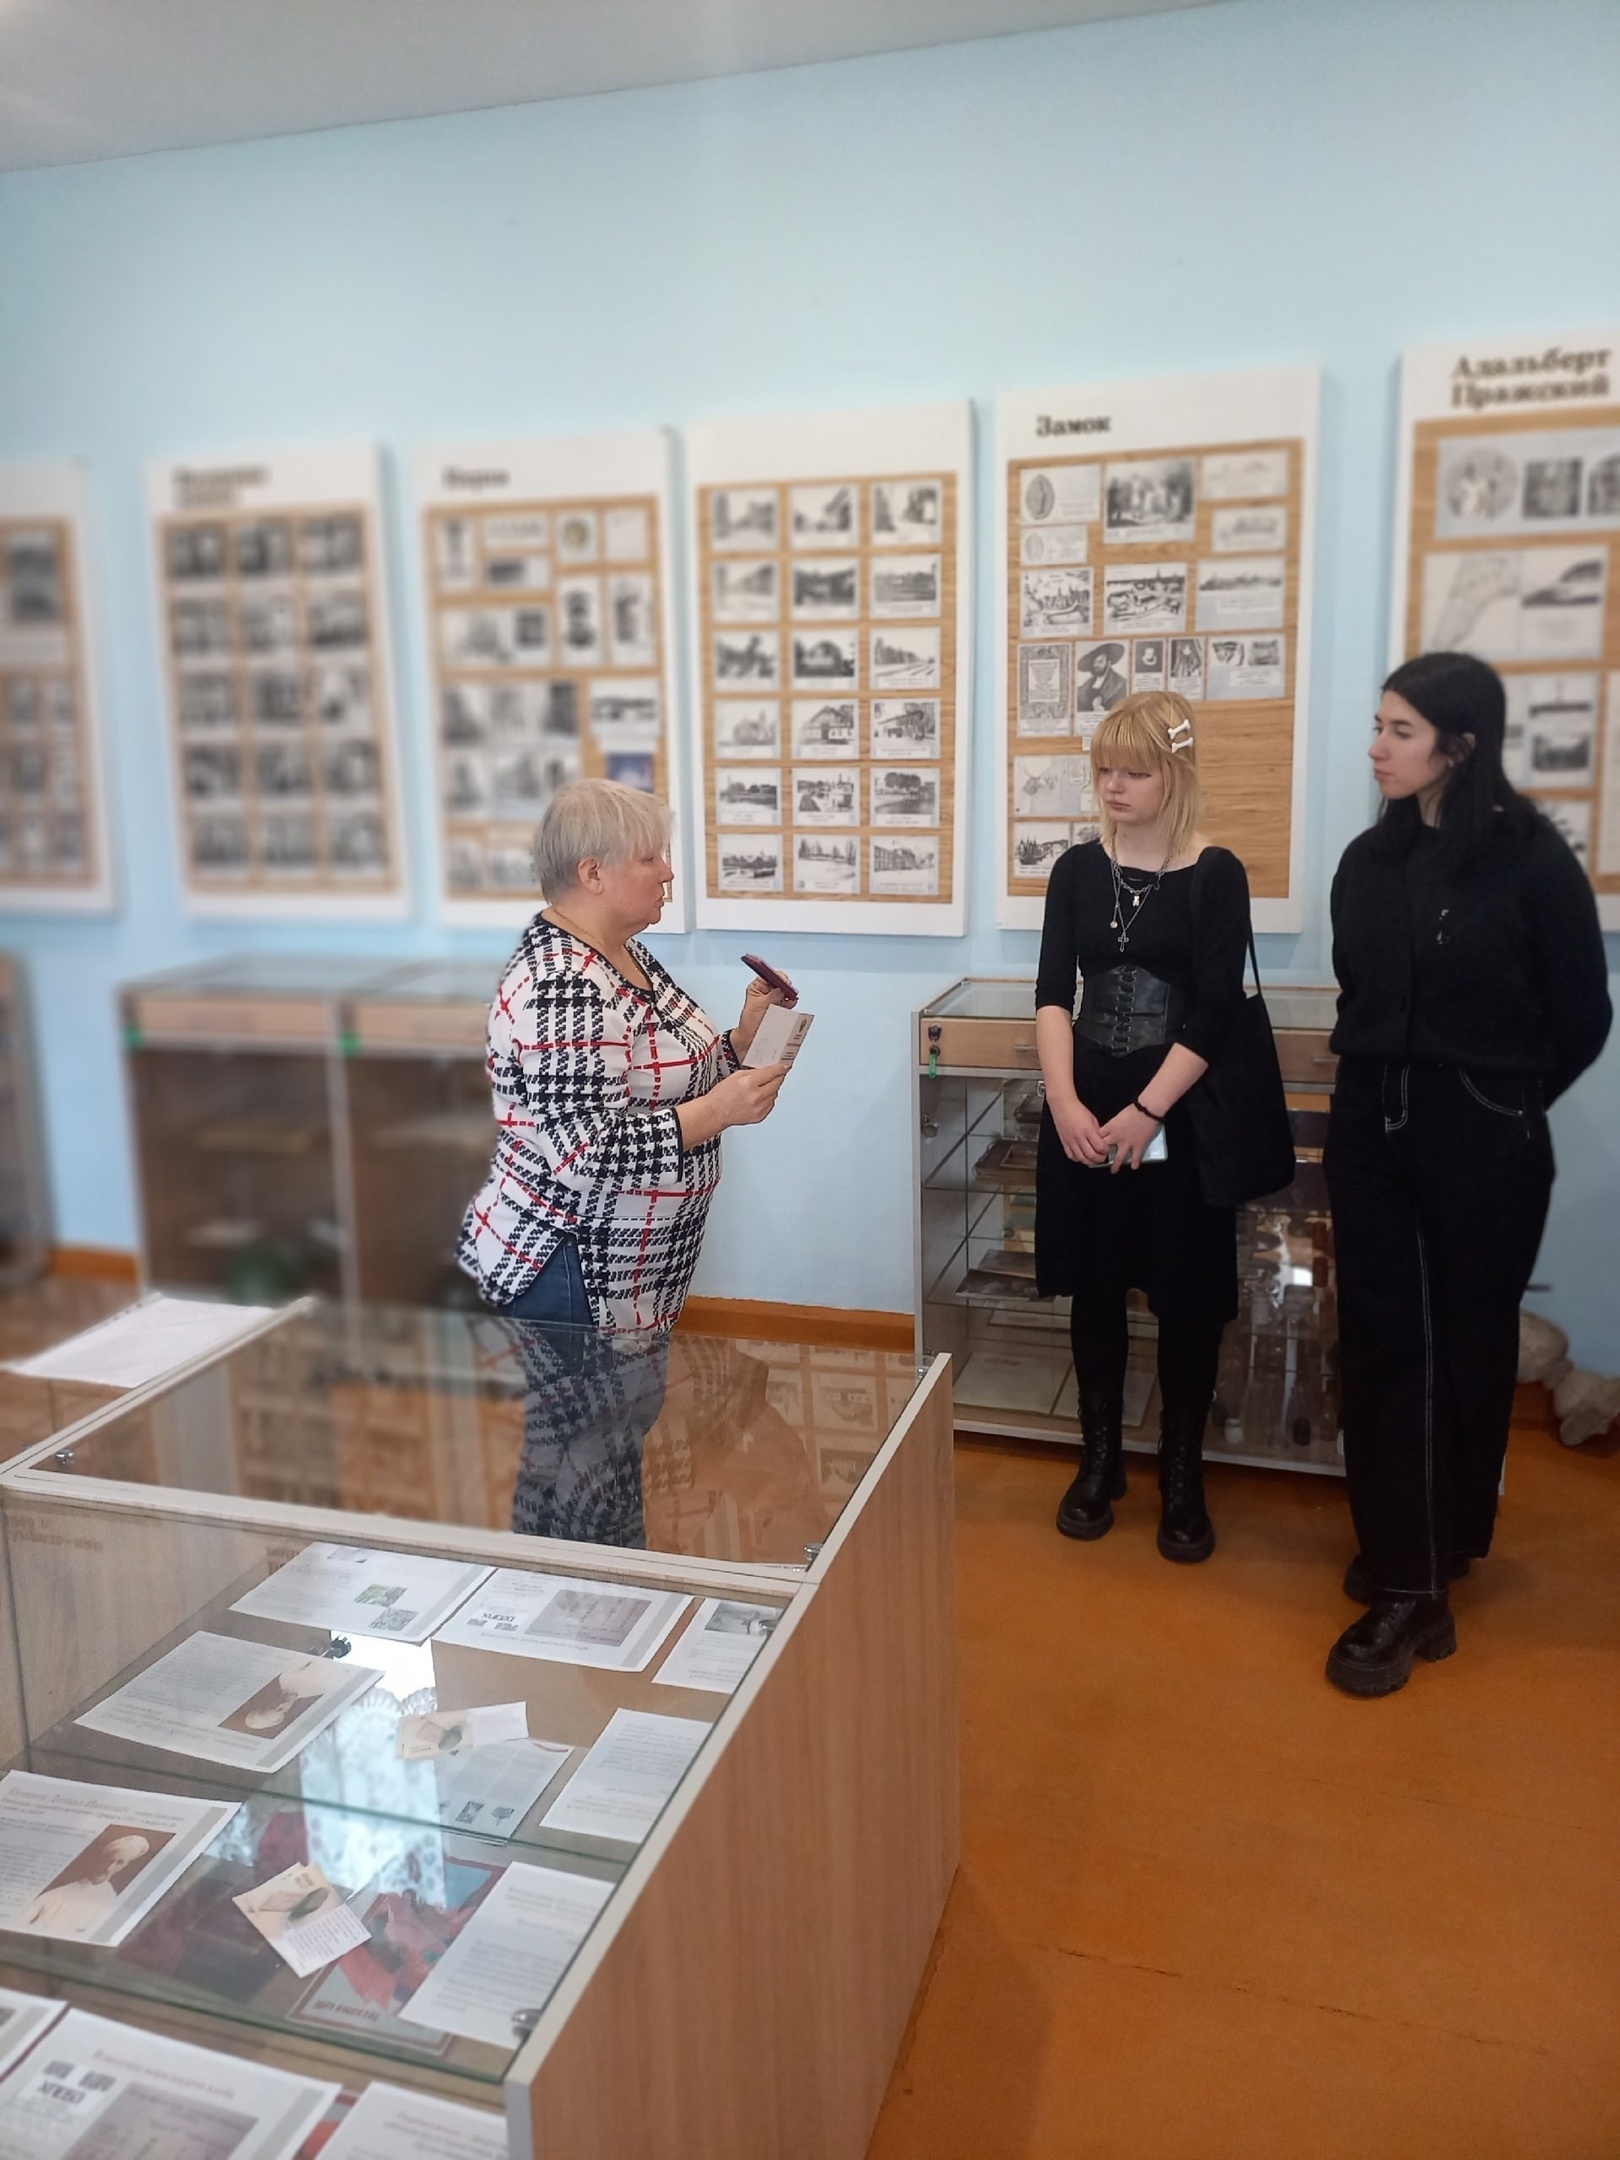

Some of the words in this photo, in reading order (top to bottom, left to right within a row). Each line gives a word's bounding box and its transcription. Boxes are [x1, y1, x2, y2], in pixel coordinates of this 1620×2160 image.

[1452, 347, 1610, 377] Адальберт
[1451, 374, 1610, 410] Пражский
[1036, 415, 1111, 437] Замок
